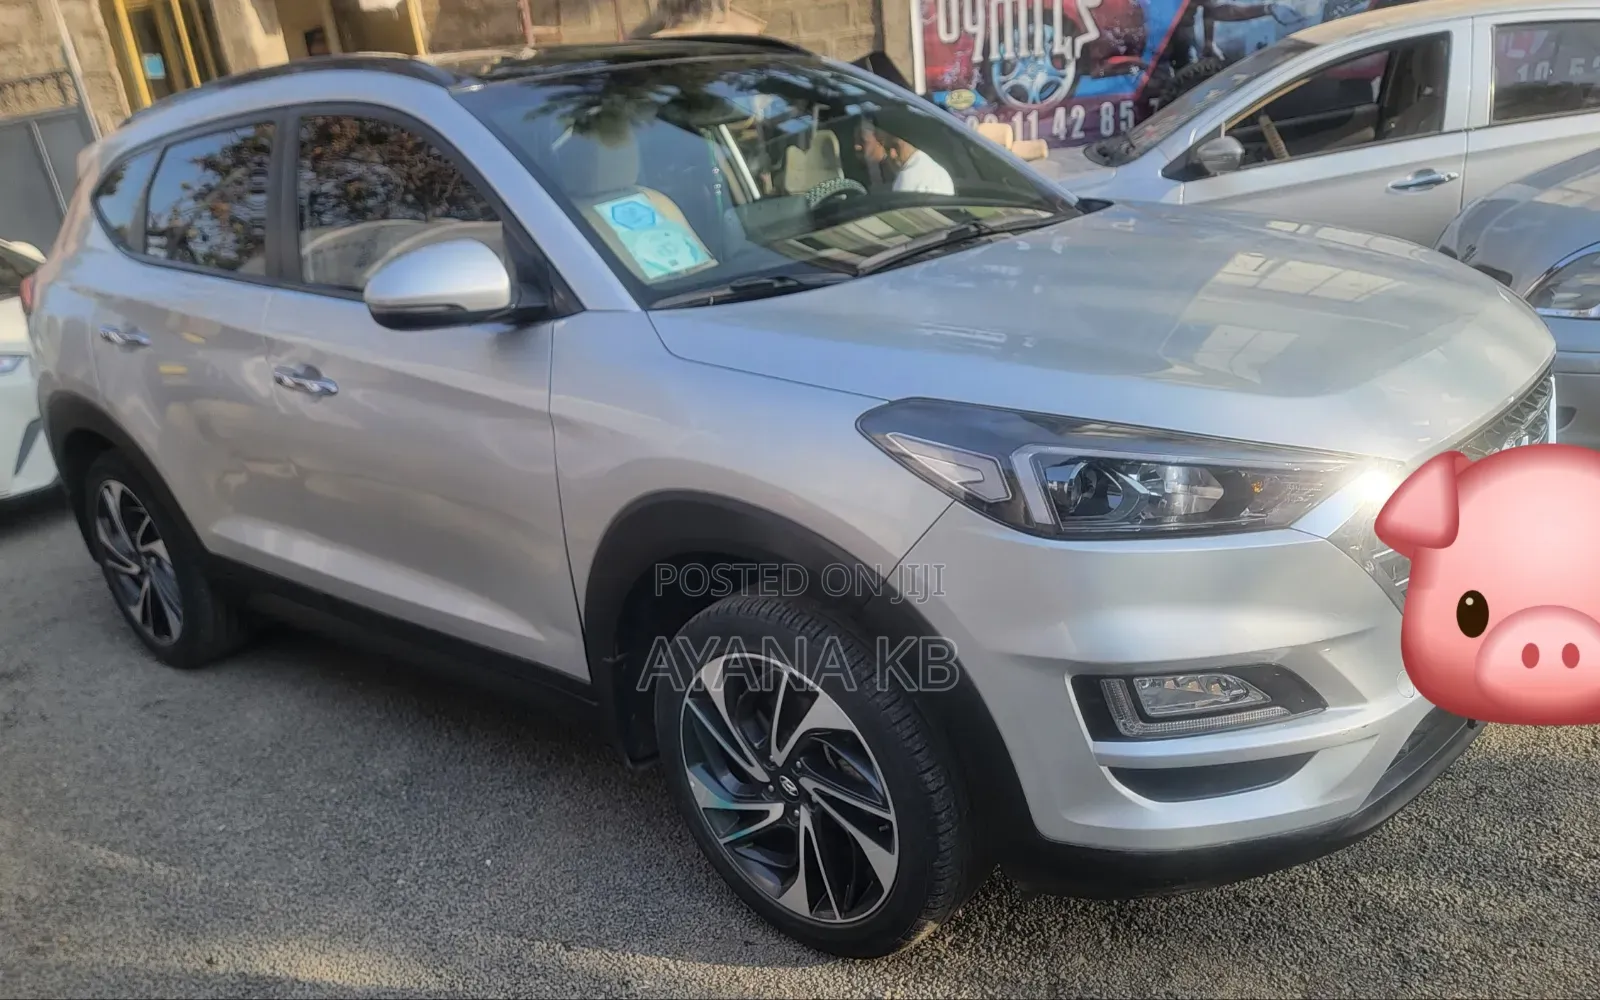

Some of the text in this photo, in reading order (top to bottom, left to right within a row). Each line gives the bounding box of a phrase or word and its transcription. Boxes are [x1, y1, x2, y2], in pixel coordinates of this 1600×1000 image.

[1011, 110, 1038, 141] 11
[1052, 104, 1085, 140] 42
[1100, 100, 1135, 137] 85
